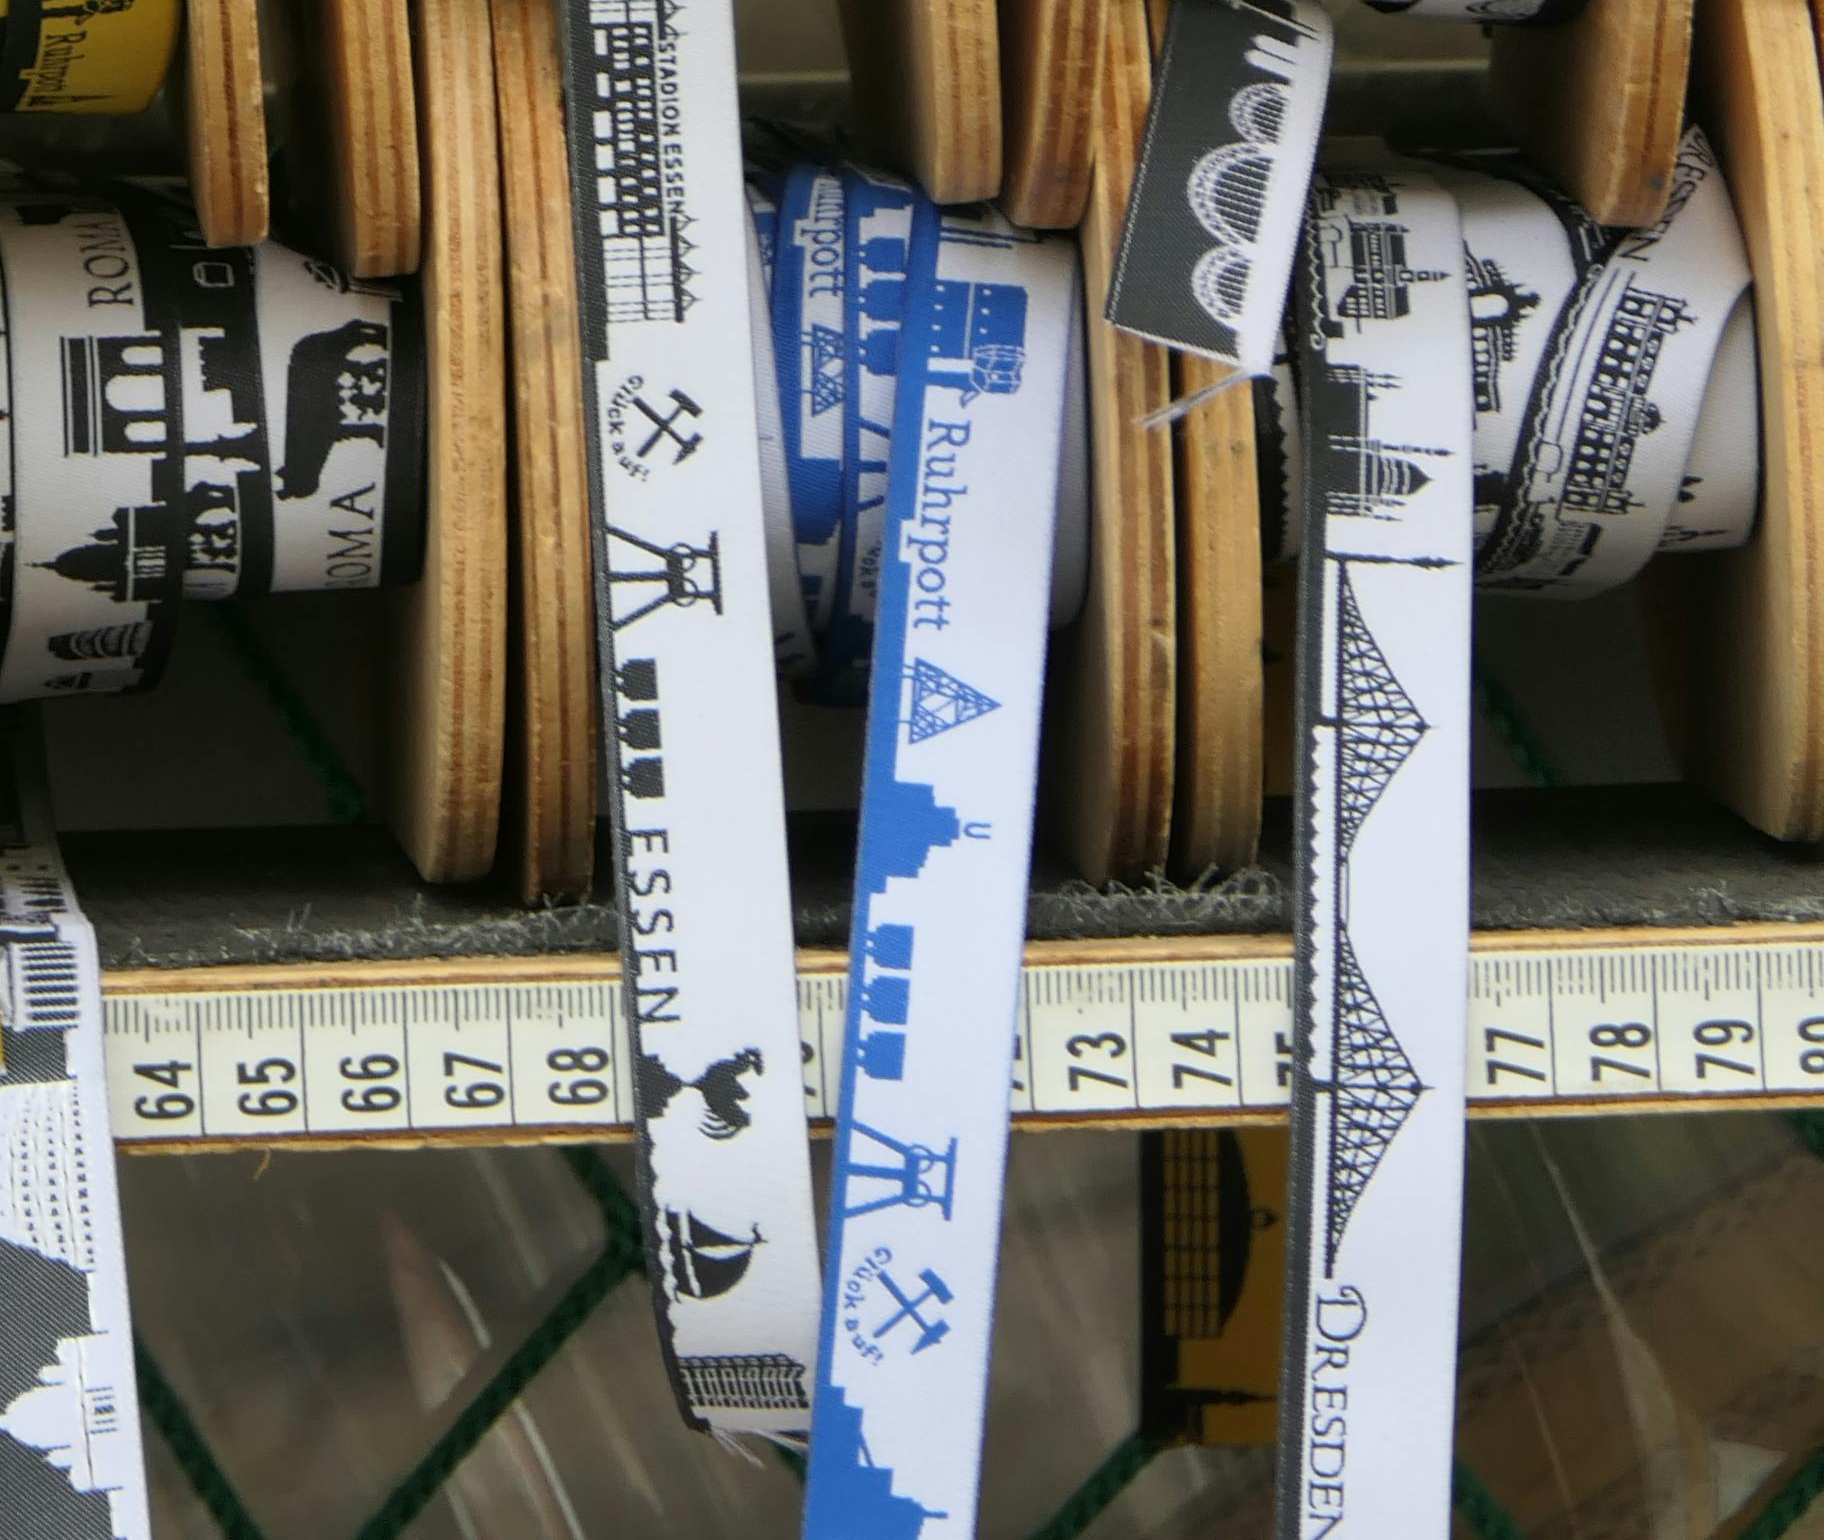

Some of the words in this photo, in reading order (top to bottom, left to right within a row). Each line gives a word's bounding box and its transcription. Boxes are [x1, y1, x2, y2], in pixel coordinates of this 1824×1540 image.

[656, 40, 681, 140] STADION
[663, 138, 687, 215] ESSEN
[79, 217, 135, 309] ROMA
[608, 373, 644, 437] Glück
[610, 441, 651, 484] auf!
[325, 481, 376, 586] OMA
[912, 418, 972, 632] Ruhrpott
[630, 828, 681, 1023] ESSEN
[548, 1049, 608, 1104] 68
[1067, 1034, 1126, 1090] 73
[1172, 1031, 1230, 1087] 74
[1487, 1030, 1544, 1083] 77
[1591, 1025, 1650, 1080] 78
[1695, 1022, 1753, 1077] 79
[135, 1062, 193, 1119] 64
[238, 1060, 297, 1115] 65
[341, 1056, 400, 1111] 66
[445, 1054, 503, 1107] 67
[842, 1245, 893, 1311] Glück
[844, 1318, 885, 1367] auf!
